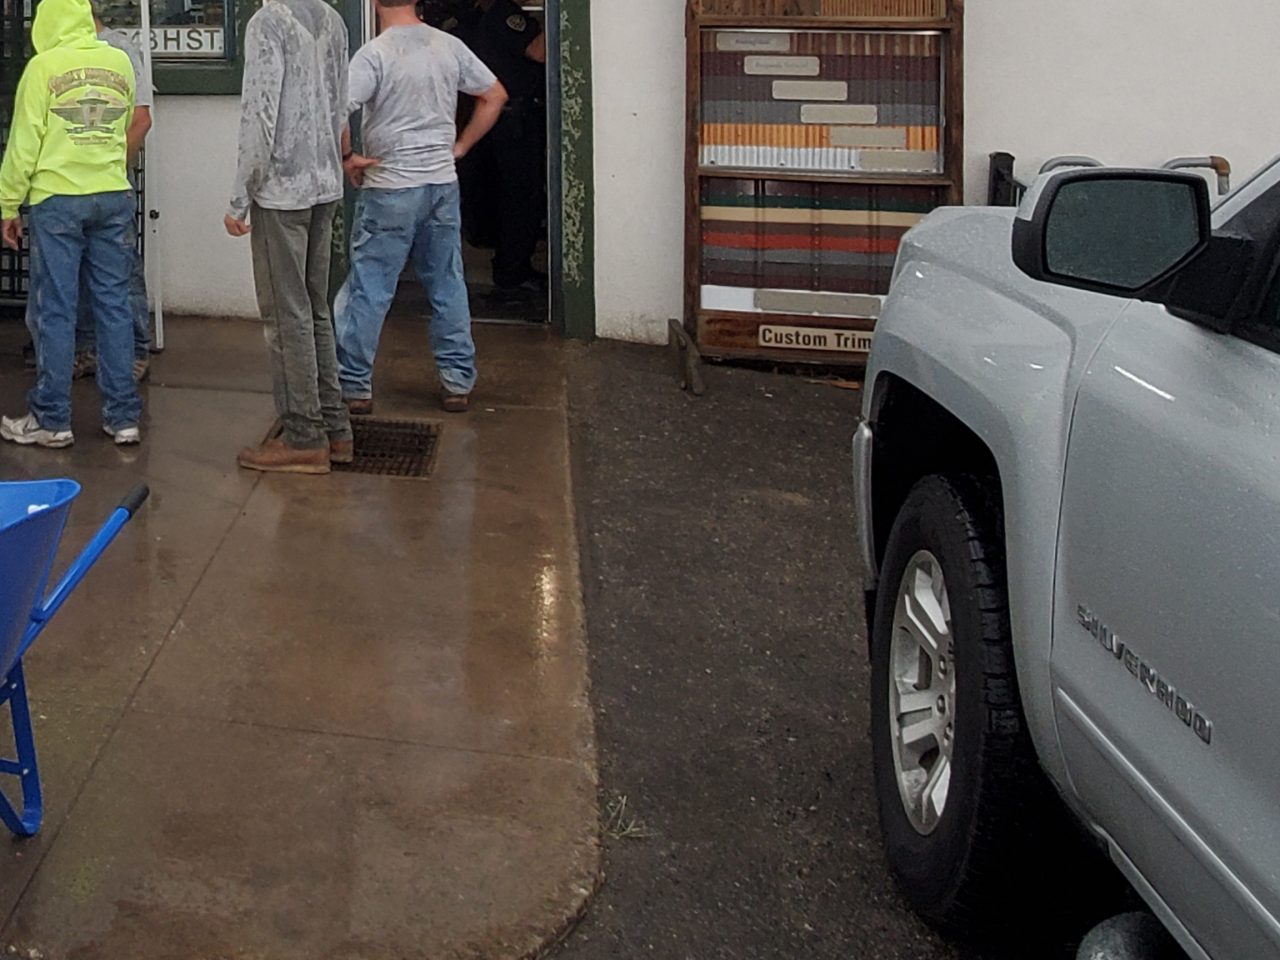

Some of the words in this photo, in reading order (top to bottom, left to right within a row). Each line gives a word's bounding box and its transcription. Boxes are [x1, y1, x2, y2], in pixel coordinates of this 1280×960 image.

[163, 29, 180, 51] H
[186, 29, 223, 51] ST.
[762, 328, 827, 347] Custom
[835, 332, 872, 349] Trim
[1077, 604, 1213, 745] SILVERADO
